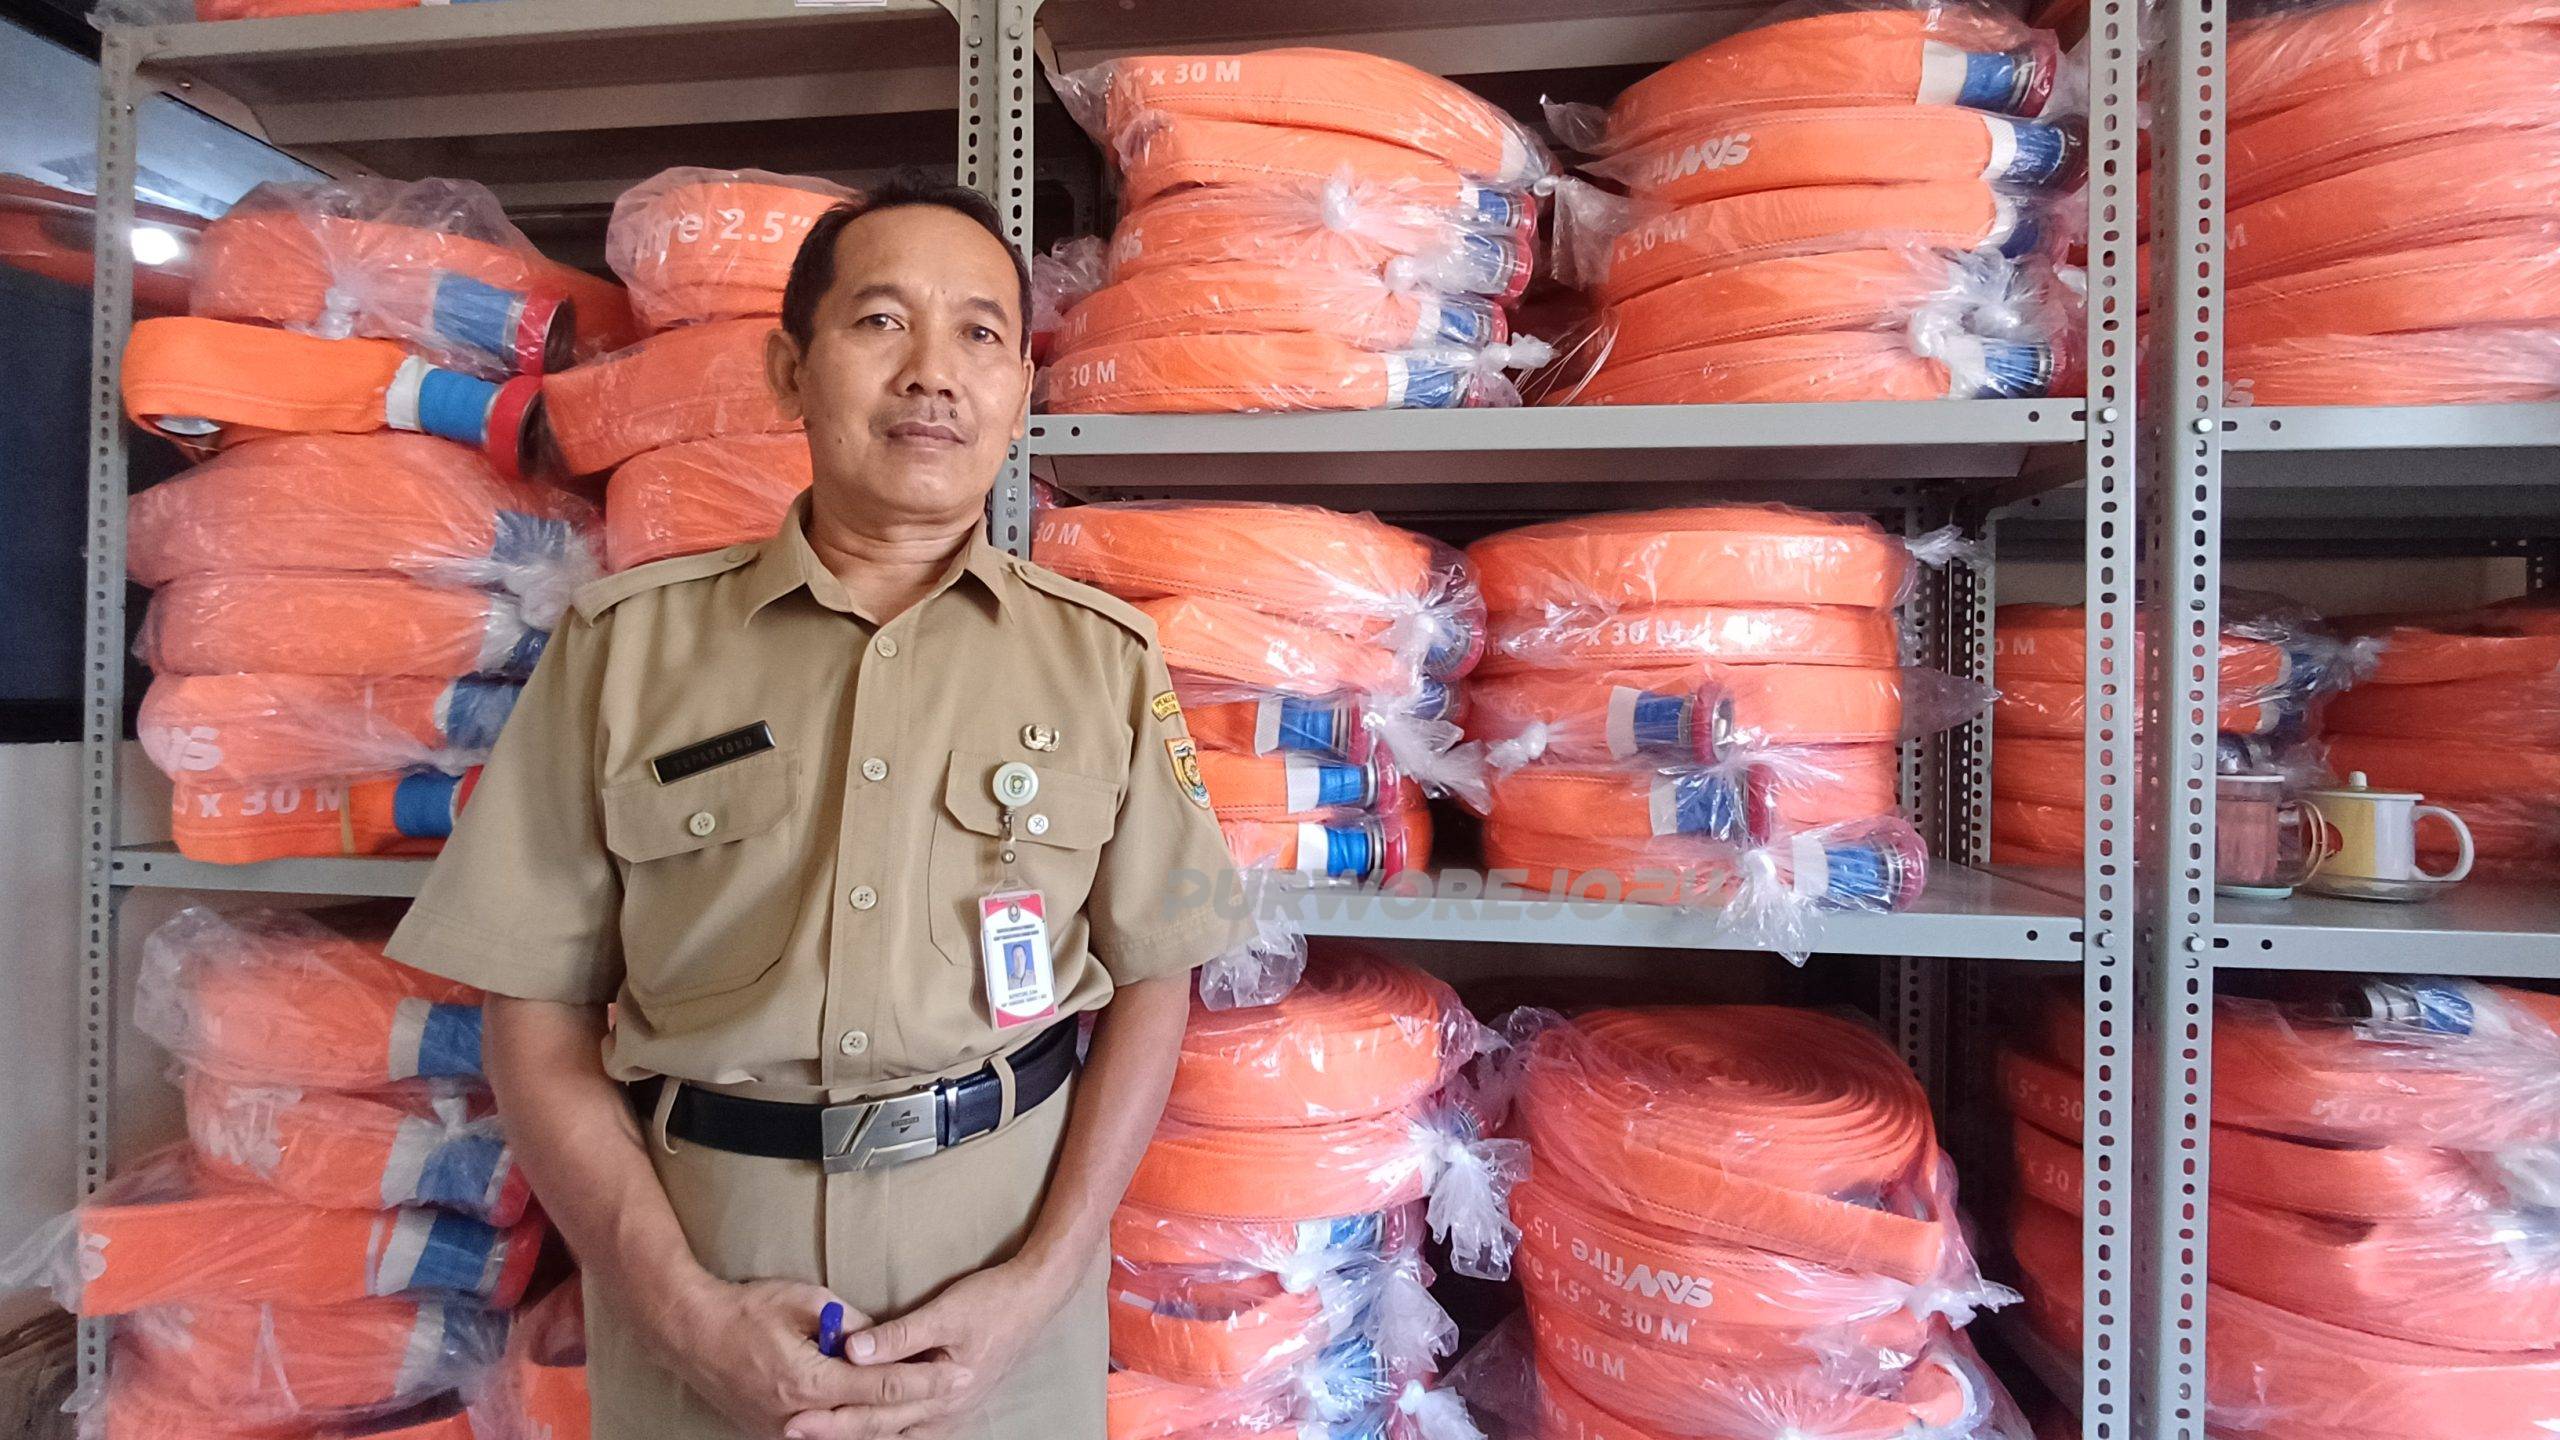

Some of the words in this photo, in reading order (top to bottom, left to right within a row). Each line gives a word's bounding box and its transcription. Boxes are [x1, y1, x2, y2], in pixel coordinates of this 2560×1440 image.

[1174, 62, 1209, 84] 30
[1214, 60, 1241, 82] M
[720, 208, 812, 244] 2.5"
[1632, 229, 1656, 257] 30
[1069, 363, 1091, 389] 30
[1033, 521, 1056, 543] 30
[1057, 522, 1082, 546] M
[1611, 620, 1649, 646] 30
[2013, 635, 2036, 656] M
[240, 781, 301, 816] 30
[2057, 1095, 2084, 1122] 30
[2043, 1163, 2070, 1192] 30
[1551, 1268, 1592, 1303] 1.5"
[1620, 1305, 1653, 1335] 30
[1570, 1337, 1596, 1369] 30
[1602, 1352, 1626, 1382] M
